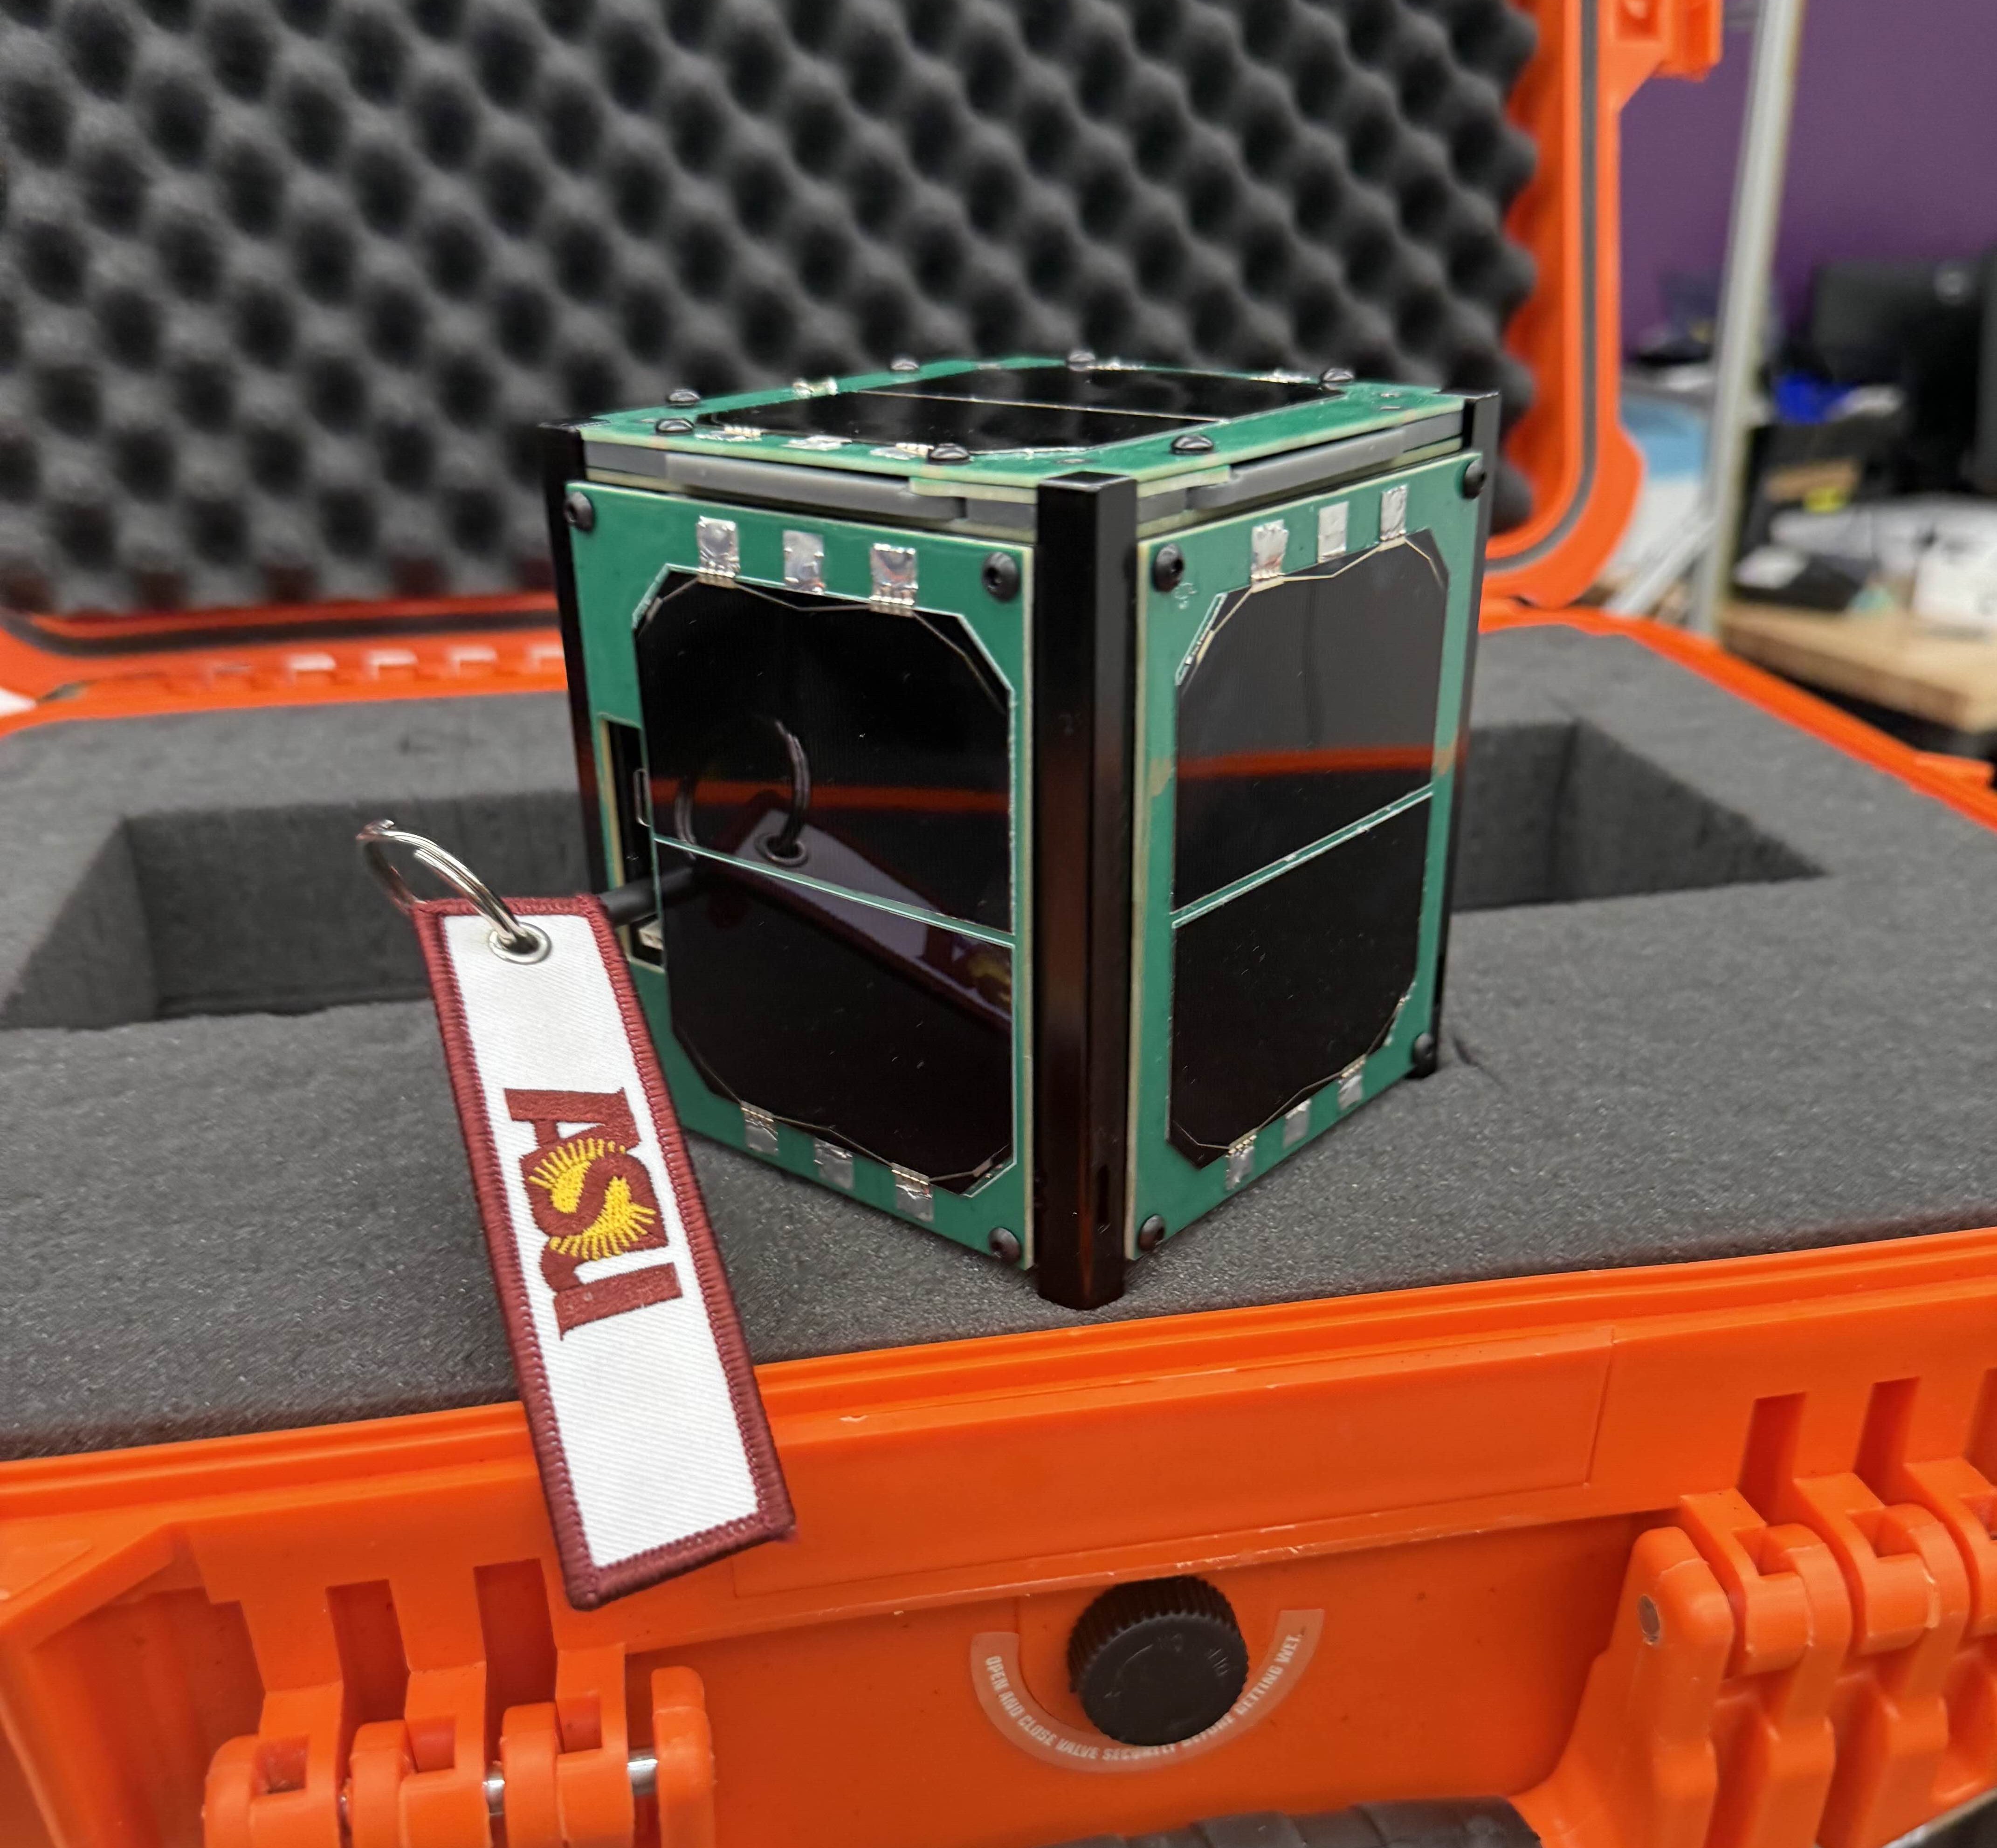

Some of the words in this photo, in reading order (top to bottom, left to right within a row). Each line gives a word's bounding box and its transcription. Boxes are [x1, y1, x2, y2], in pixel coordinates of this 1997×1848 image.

[504, 1087, 683, 1341] ASU
[985, 1656, 1009, 1691] OPEN
[998, 1690, 1025, 1717] AND
[1017, 1715, 1057, 1746] CLOSE
[1055, 1738, 1099, 1759] VALVE
[1235, 1665, 1283, 1715] GETTING
